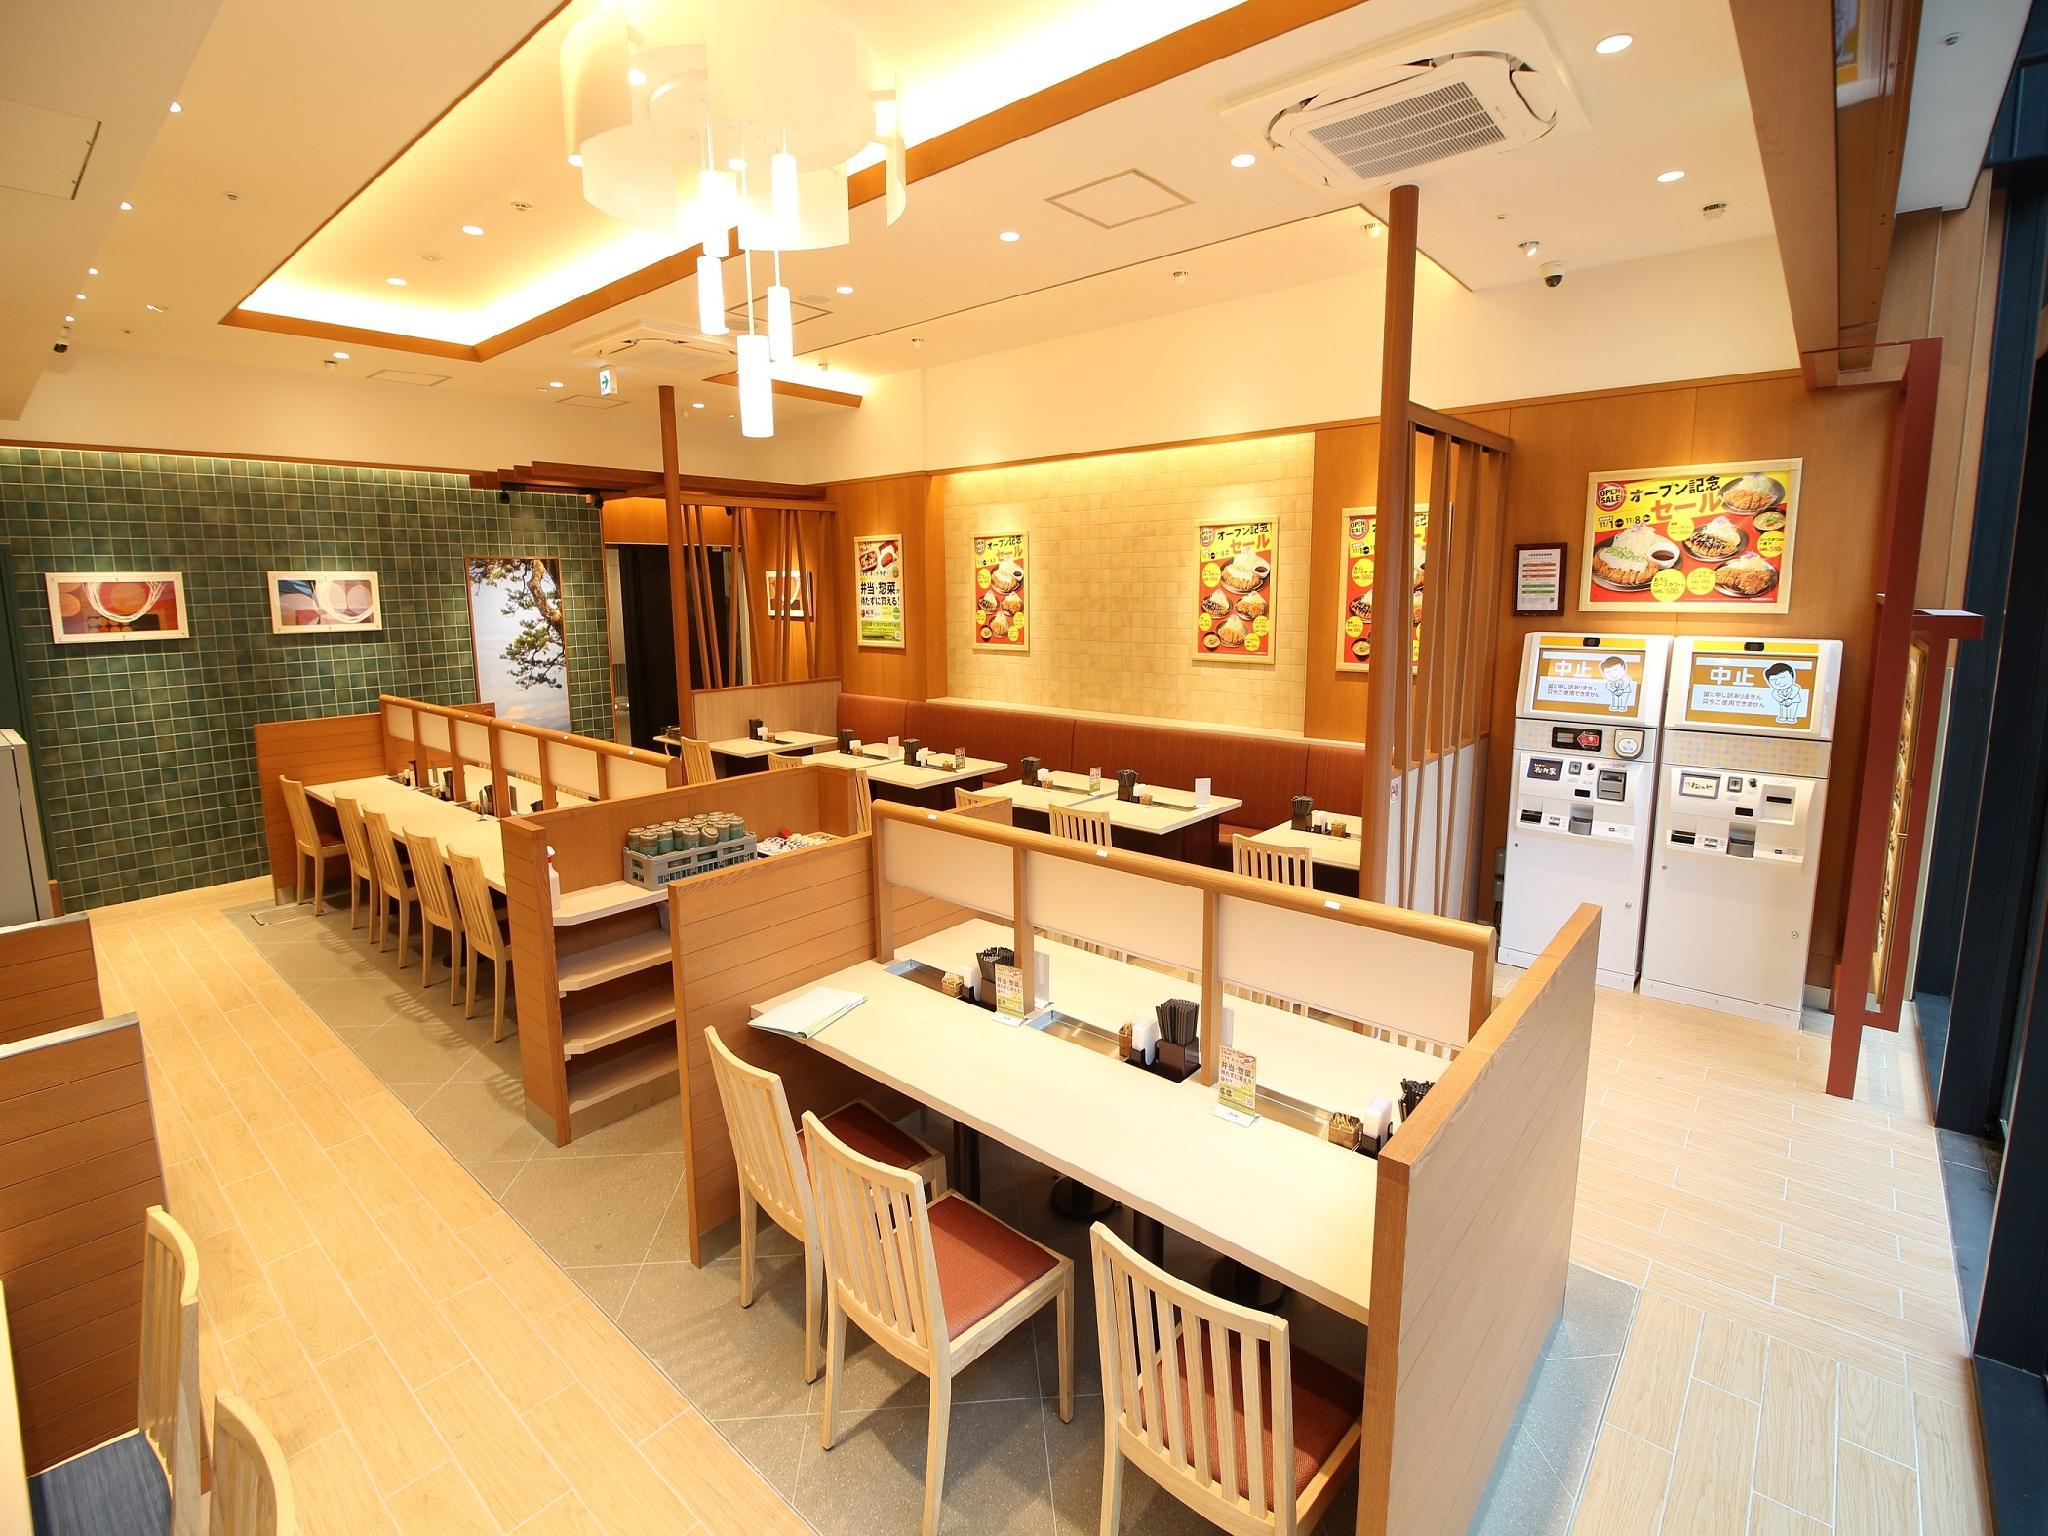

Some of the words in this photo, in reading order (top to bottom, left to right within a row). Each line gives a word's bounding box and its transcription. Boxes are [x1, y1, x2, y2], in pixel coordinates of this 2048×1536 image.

[1599, 488, 1621, 498] OPEN
[1630, 476, 1721, 503] オープン記念
[1600, 495, 1621, 504] SALE
[1651, 493, 1724, 521] セール
[1231, 534, 1270, 555] セール
[1554, 660, 1592, 678] 中止
[1709, 667, 1755, 687] 中止
[1547, 689, 1600, 698] 只今ご使用できません
[1703, 691, 1762, 701] 誠に申し訳ありません
[1702, 699, 1765, 709] 只今ご使用できません
